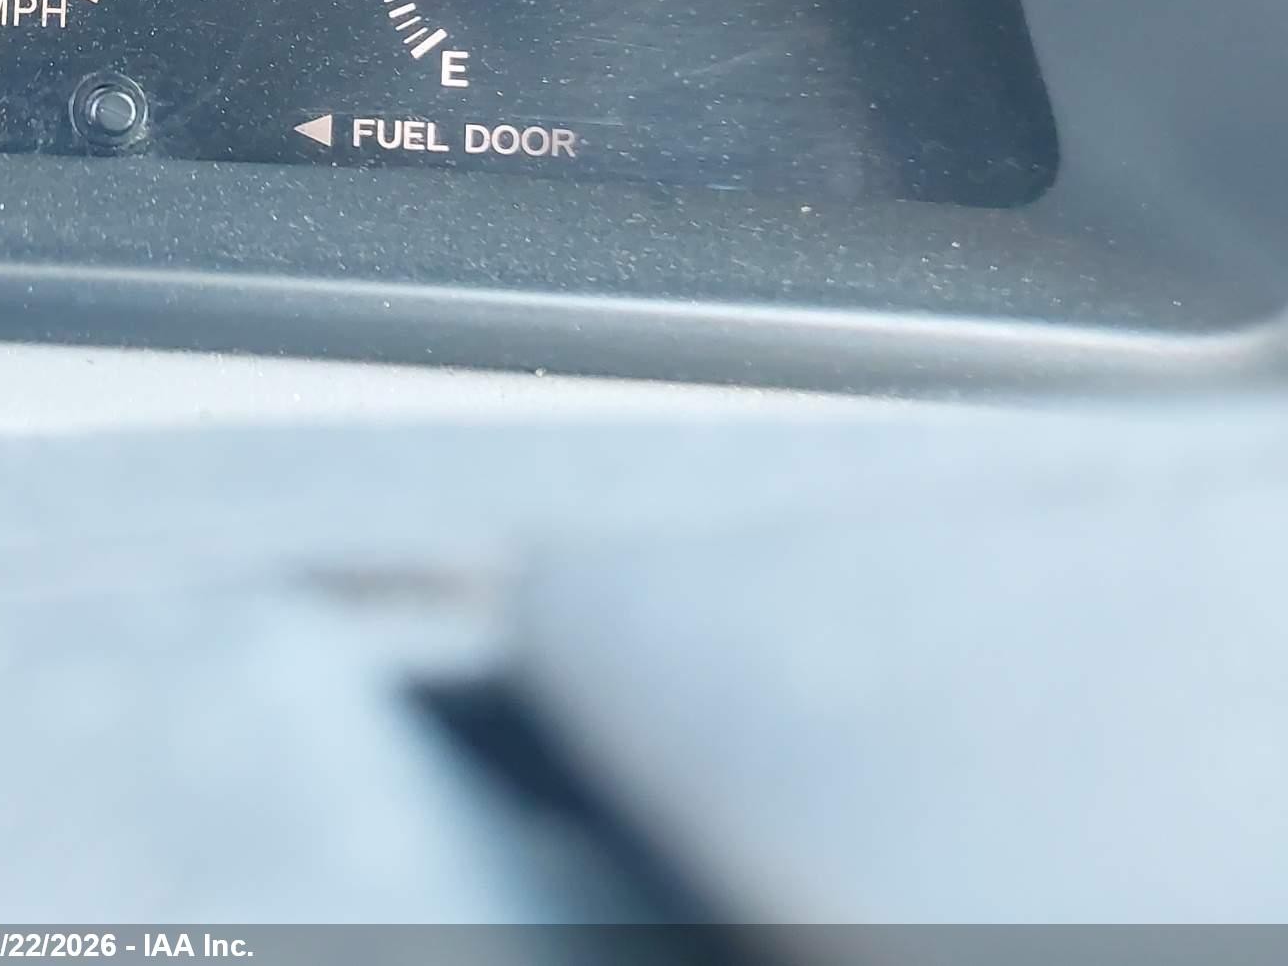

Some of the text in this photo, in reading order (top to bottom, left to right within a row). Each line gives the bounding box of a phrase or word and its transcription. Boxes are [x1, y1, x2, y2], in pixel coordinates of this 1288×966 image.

[441, 50, 469, 88] E
[353, 118, 575, 157] FUEL DOOR
